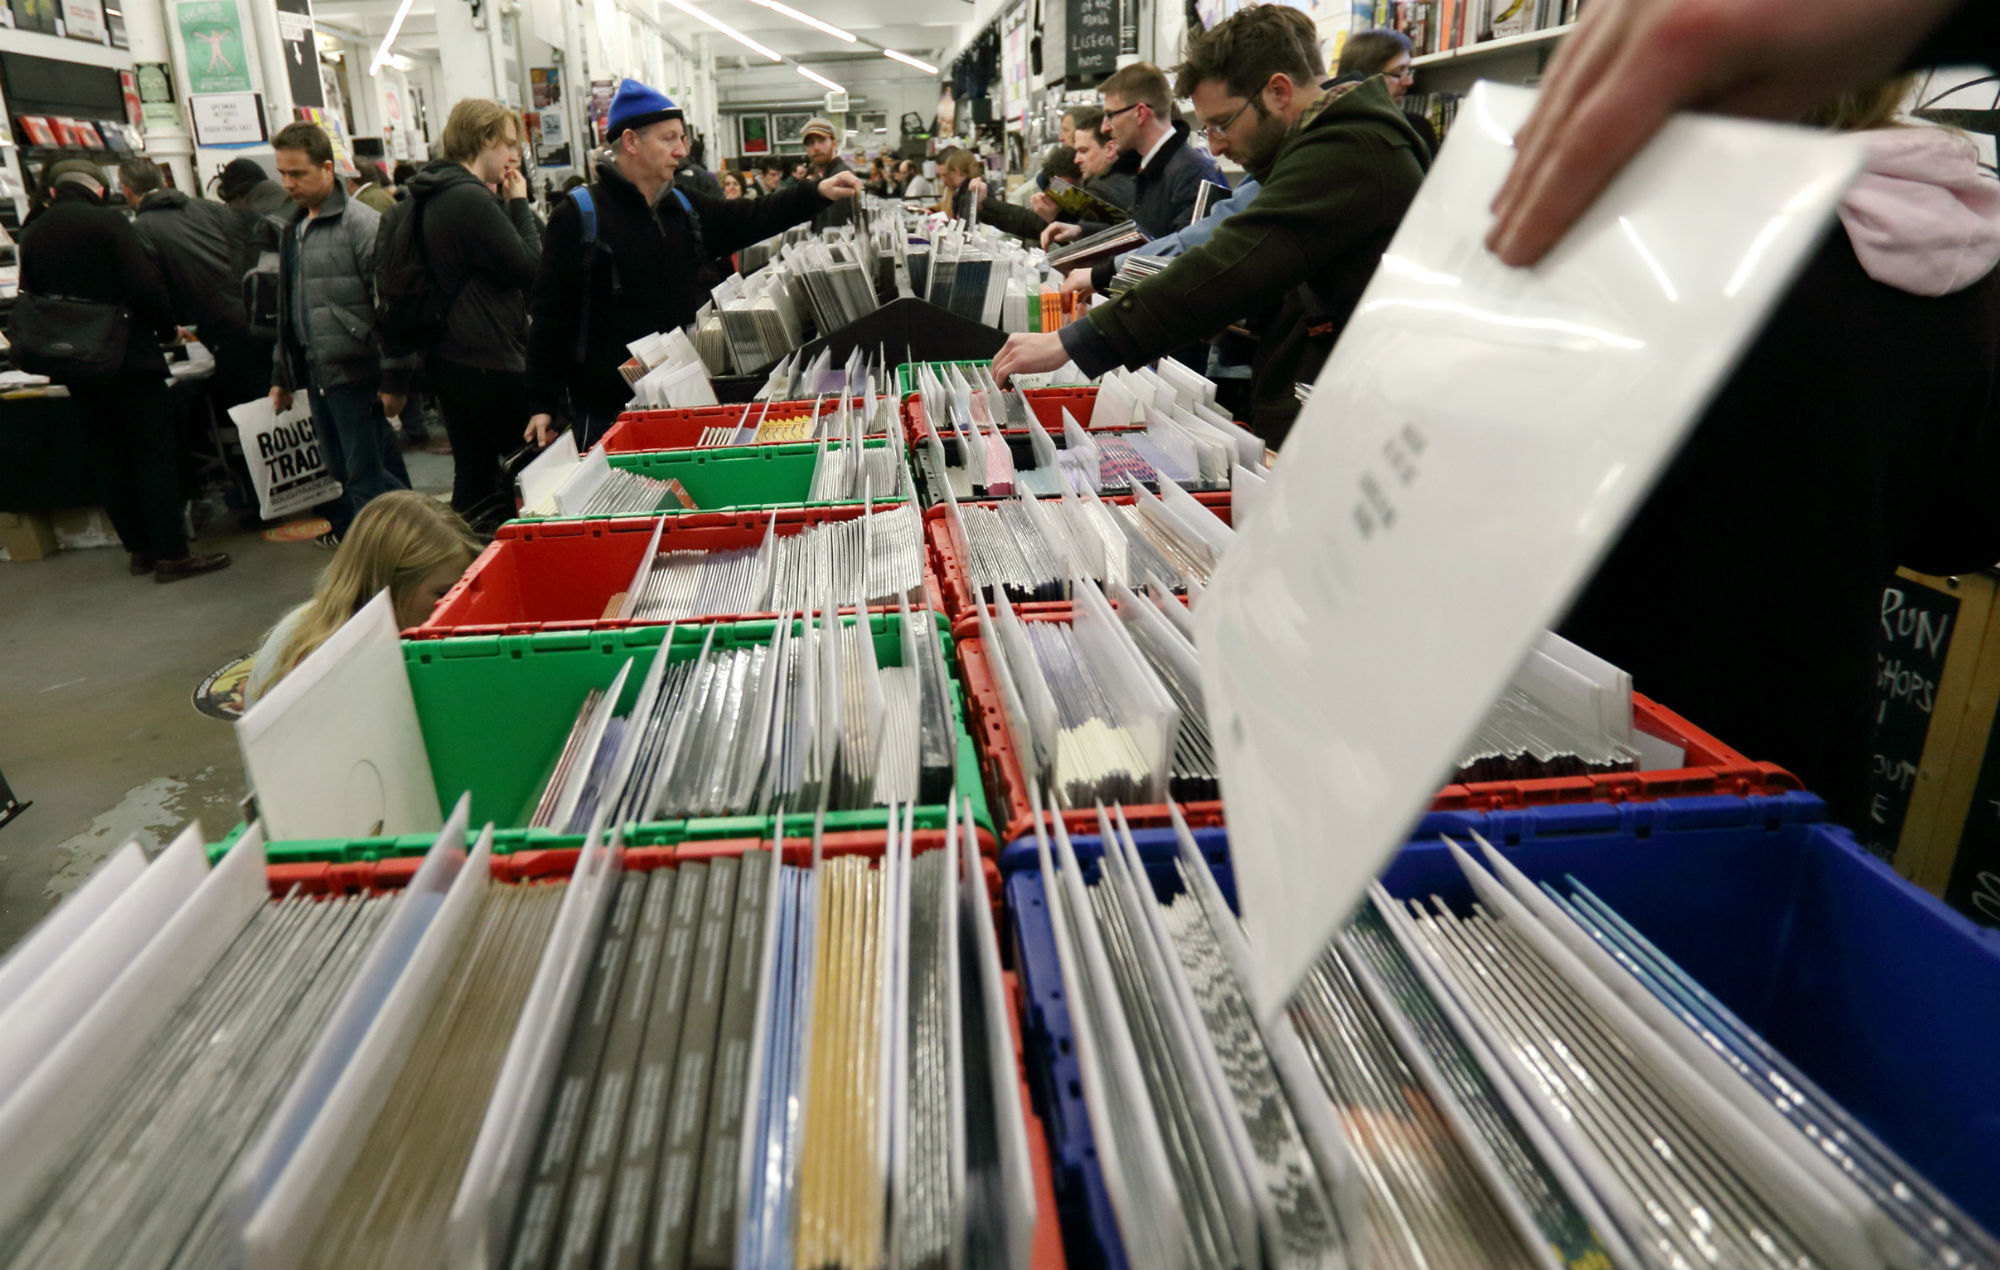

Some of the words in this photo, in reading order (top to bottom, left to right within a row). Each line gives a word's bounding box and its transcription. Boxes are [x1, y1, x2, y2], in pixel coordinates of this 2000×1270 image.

[1072, 33, 1114, 50] Listen
[264, 445, 322, 484] TRAD
[1881, 587, 1948, 659] RUN
